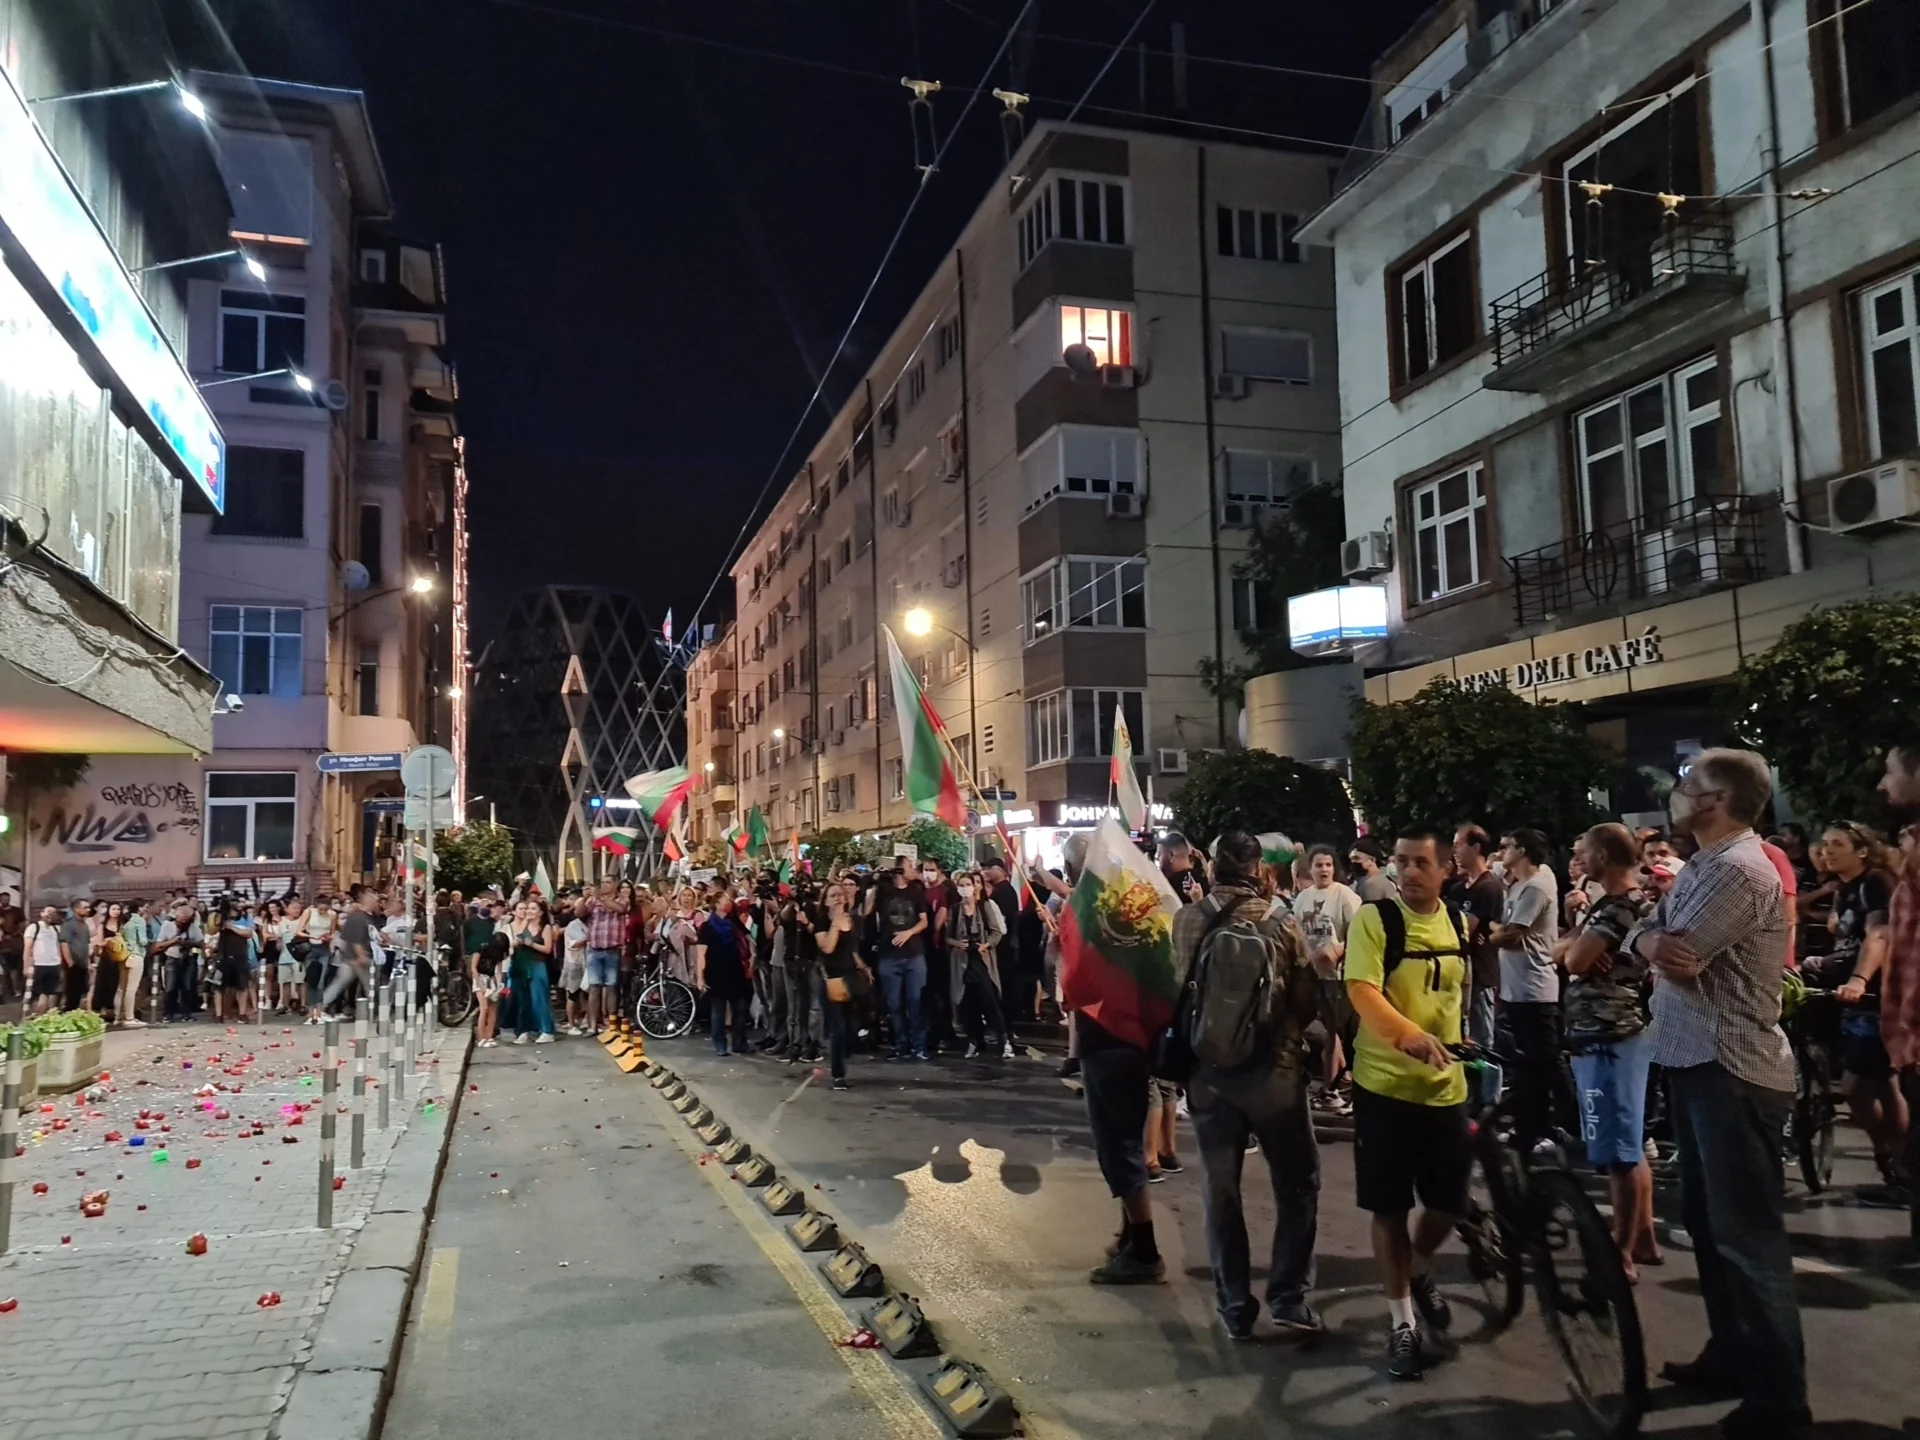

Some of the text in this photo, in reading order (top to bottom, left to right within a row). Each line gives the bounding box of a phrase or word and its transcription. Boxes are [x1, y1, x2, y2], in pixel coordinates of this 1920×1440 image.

[1513, 653, 1575, 689] DELI
[1581, 626, 1663, 674] CAFÉ
[1057, 804, 1121, 825] JOHNN
